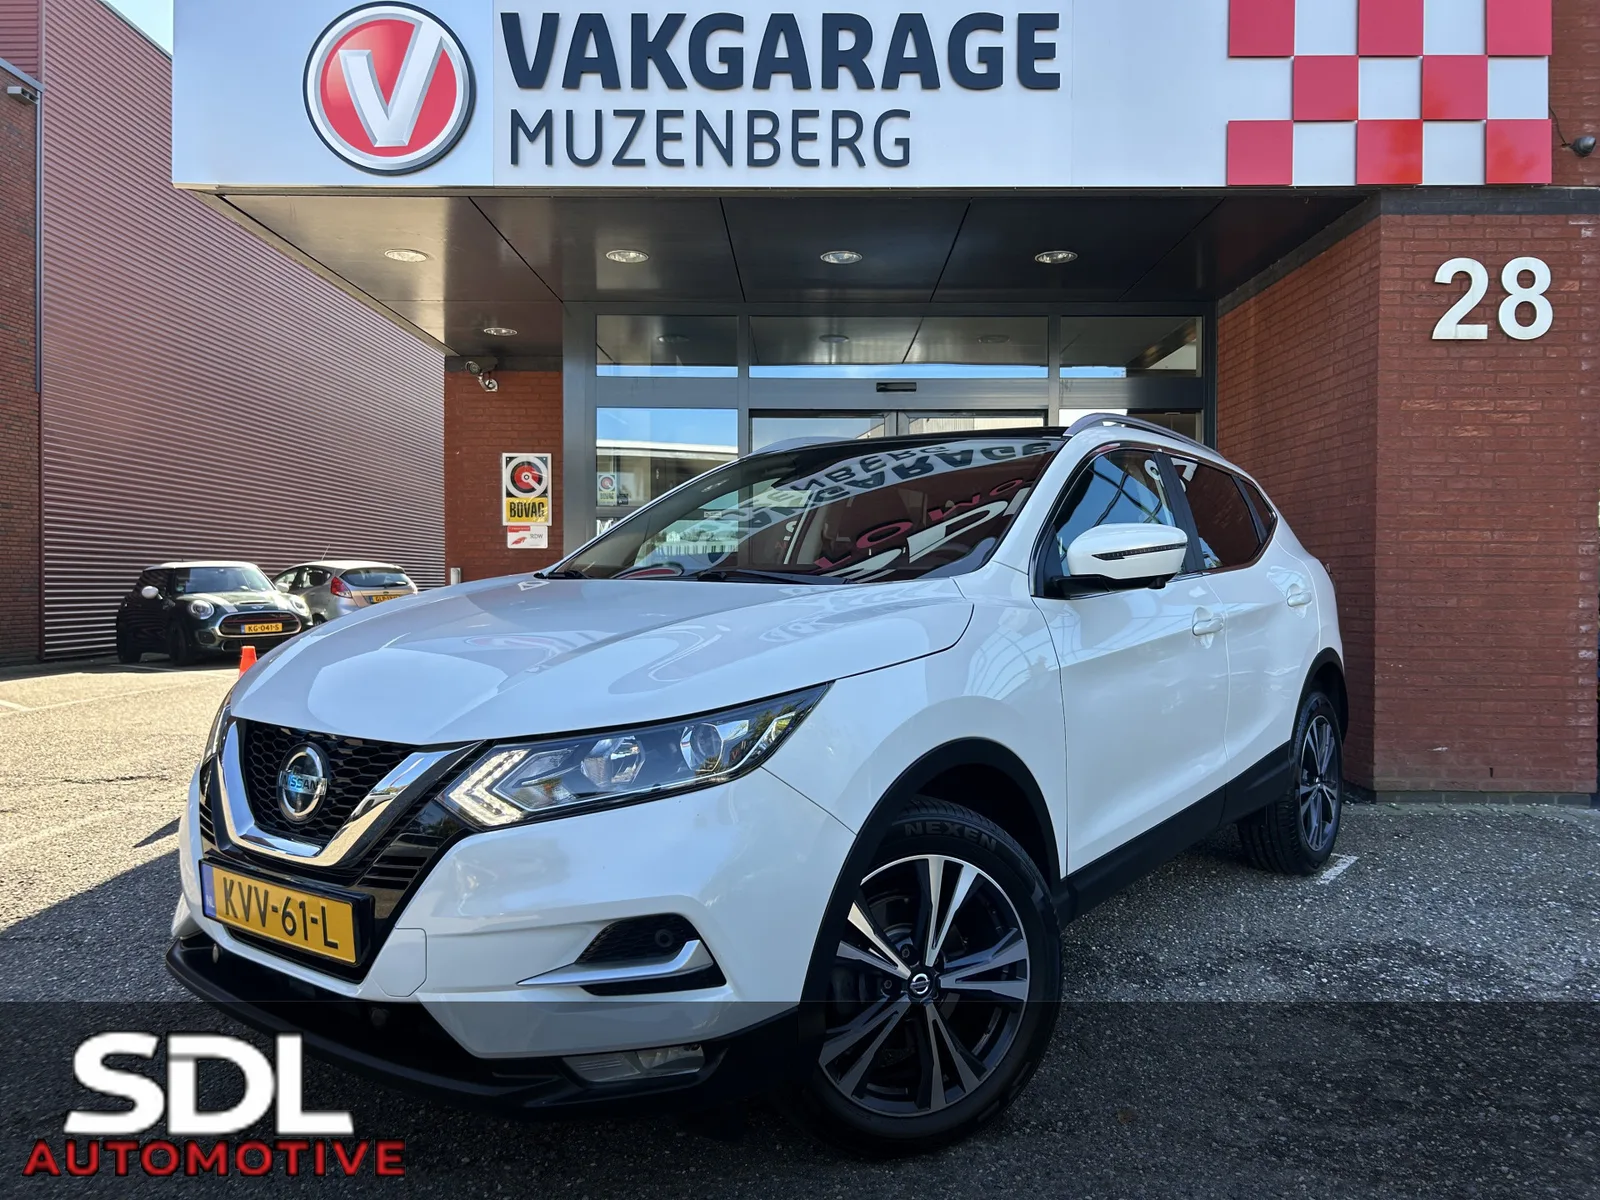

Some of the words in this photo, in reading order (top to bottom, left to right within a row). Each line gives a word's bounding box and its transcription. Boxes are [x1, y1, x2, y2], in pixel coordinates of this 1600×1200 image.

[500, 12, 1061, 90] VAKGARAGE
[509, 108, 911, 167] MUZENBERG
[1431, 256, 1554, 341] 28
[509, 501, 545, 518] BOVAG
[282, 772, 320, 791] NISSAN
[904, 820, 997, 851] NEXEN
[223, 876, 339, 950] KVV-61-L
